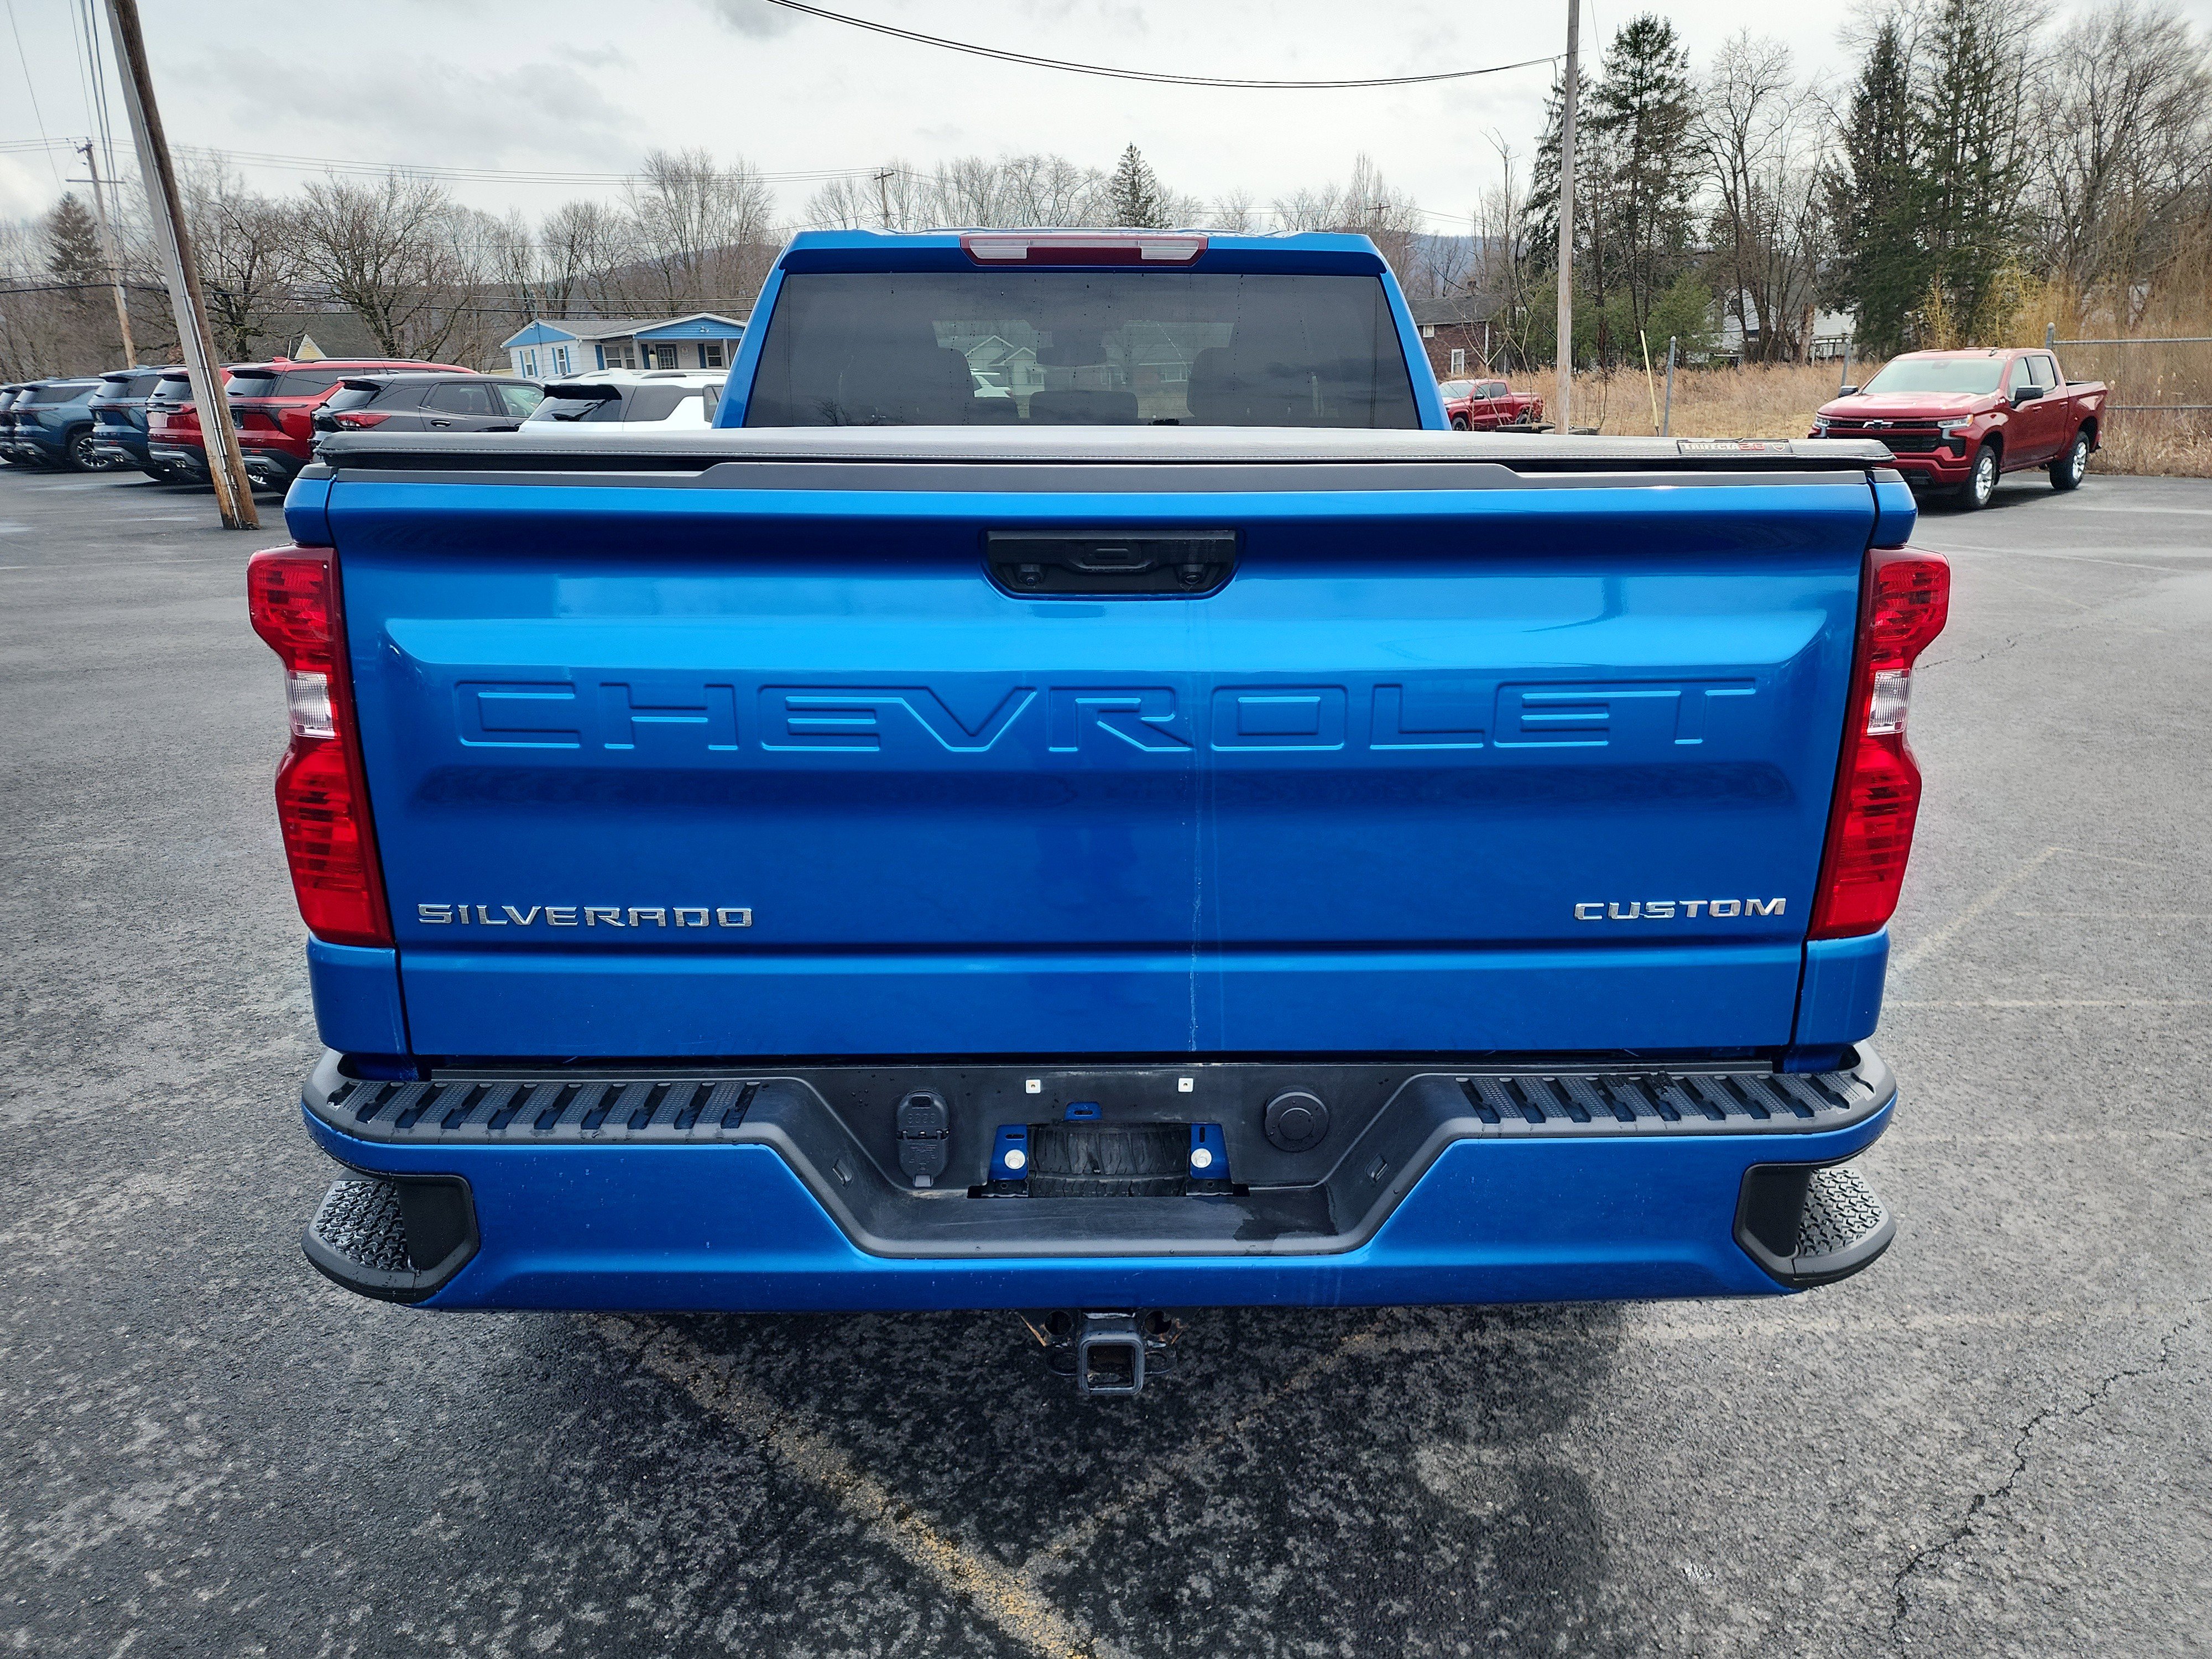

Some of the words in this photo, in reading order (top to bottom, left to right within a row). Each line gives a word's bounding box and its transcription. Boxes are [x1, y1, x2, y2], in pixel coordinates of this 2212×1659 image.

[453, 679, 1756, 752] CHEVROLET
[418, 903, 753, 927] SILVERADO
[1574, 898, 1787, 920] CUSTOM
